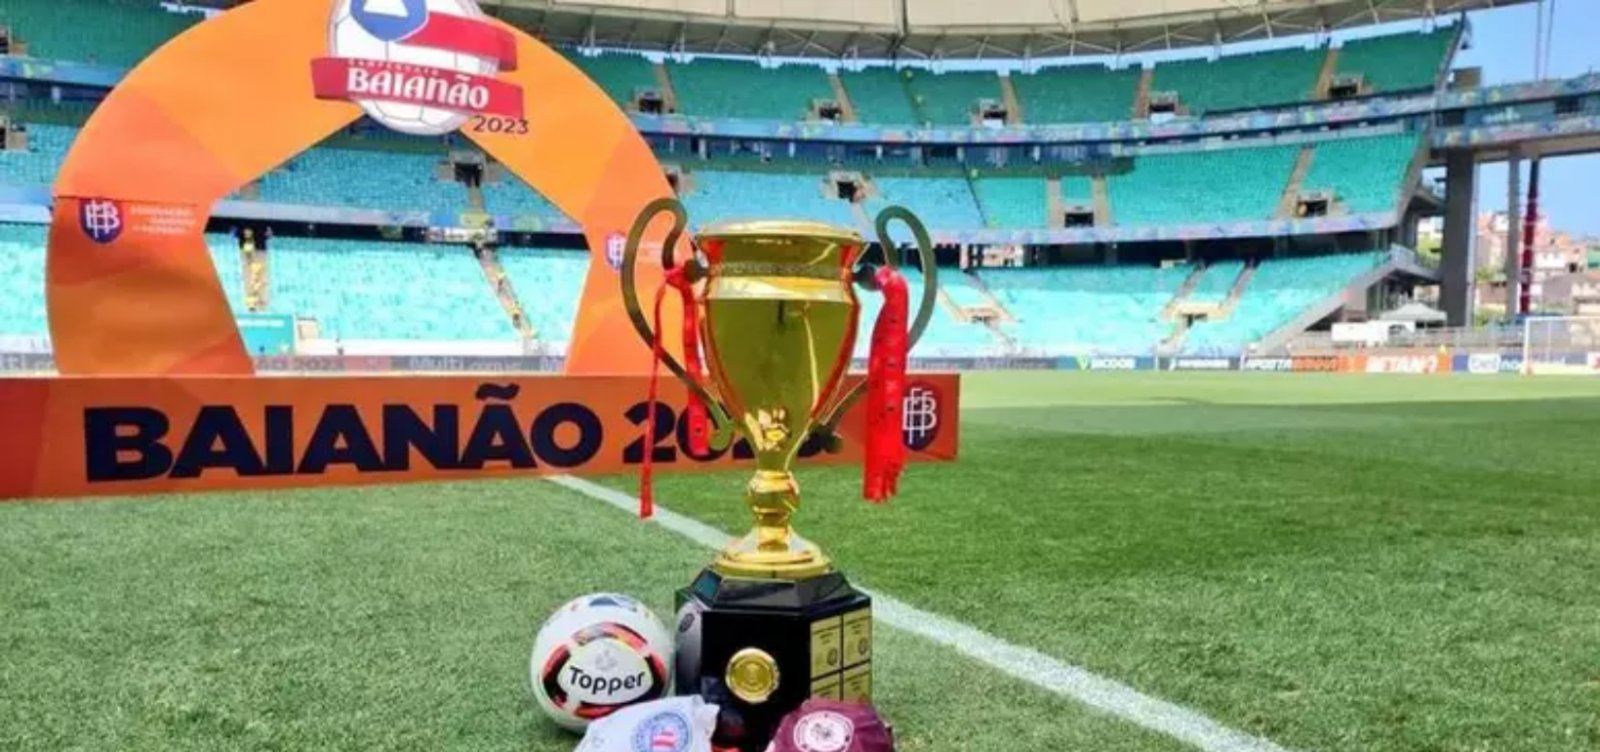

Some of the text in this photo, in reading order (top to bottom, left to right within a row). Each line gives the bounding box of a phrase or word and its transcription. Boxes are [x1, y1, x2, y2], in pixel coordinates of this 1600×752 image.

[472, 114, 530, 135] 2023
[84, 382, 604, 482] BAIANÃO
[569, 665, 646, 696] Topper
